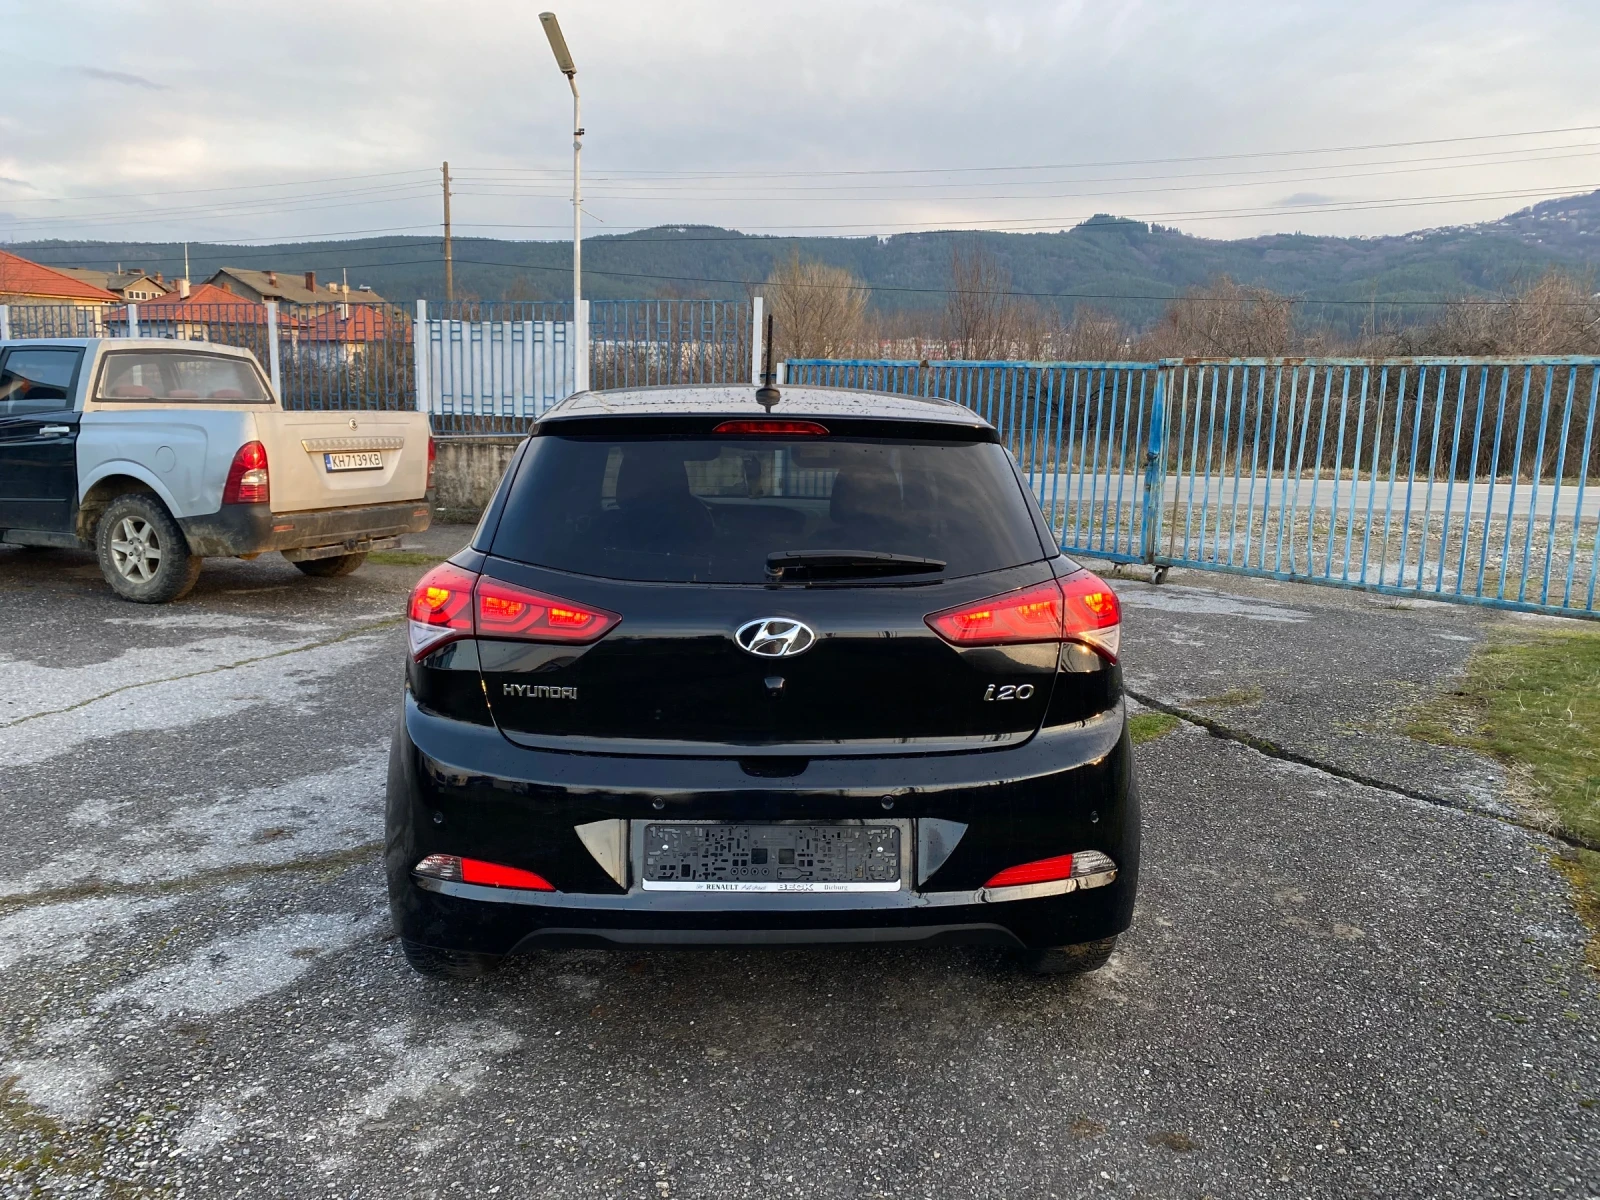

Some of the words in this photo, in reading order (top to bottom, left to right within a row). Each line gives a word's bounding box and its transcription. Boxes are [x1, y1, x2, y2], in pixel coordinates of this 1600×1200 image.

[503, 683, 577, 700] HYUNDAI
[983, 683, 1035, 701] i20
[777, 883, 814, 891] BECK
